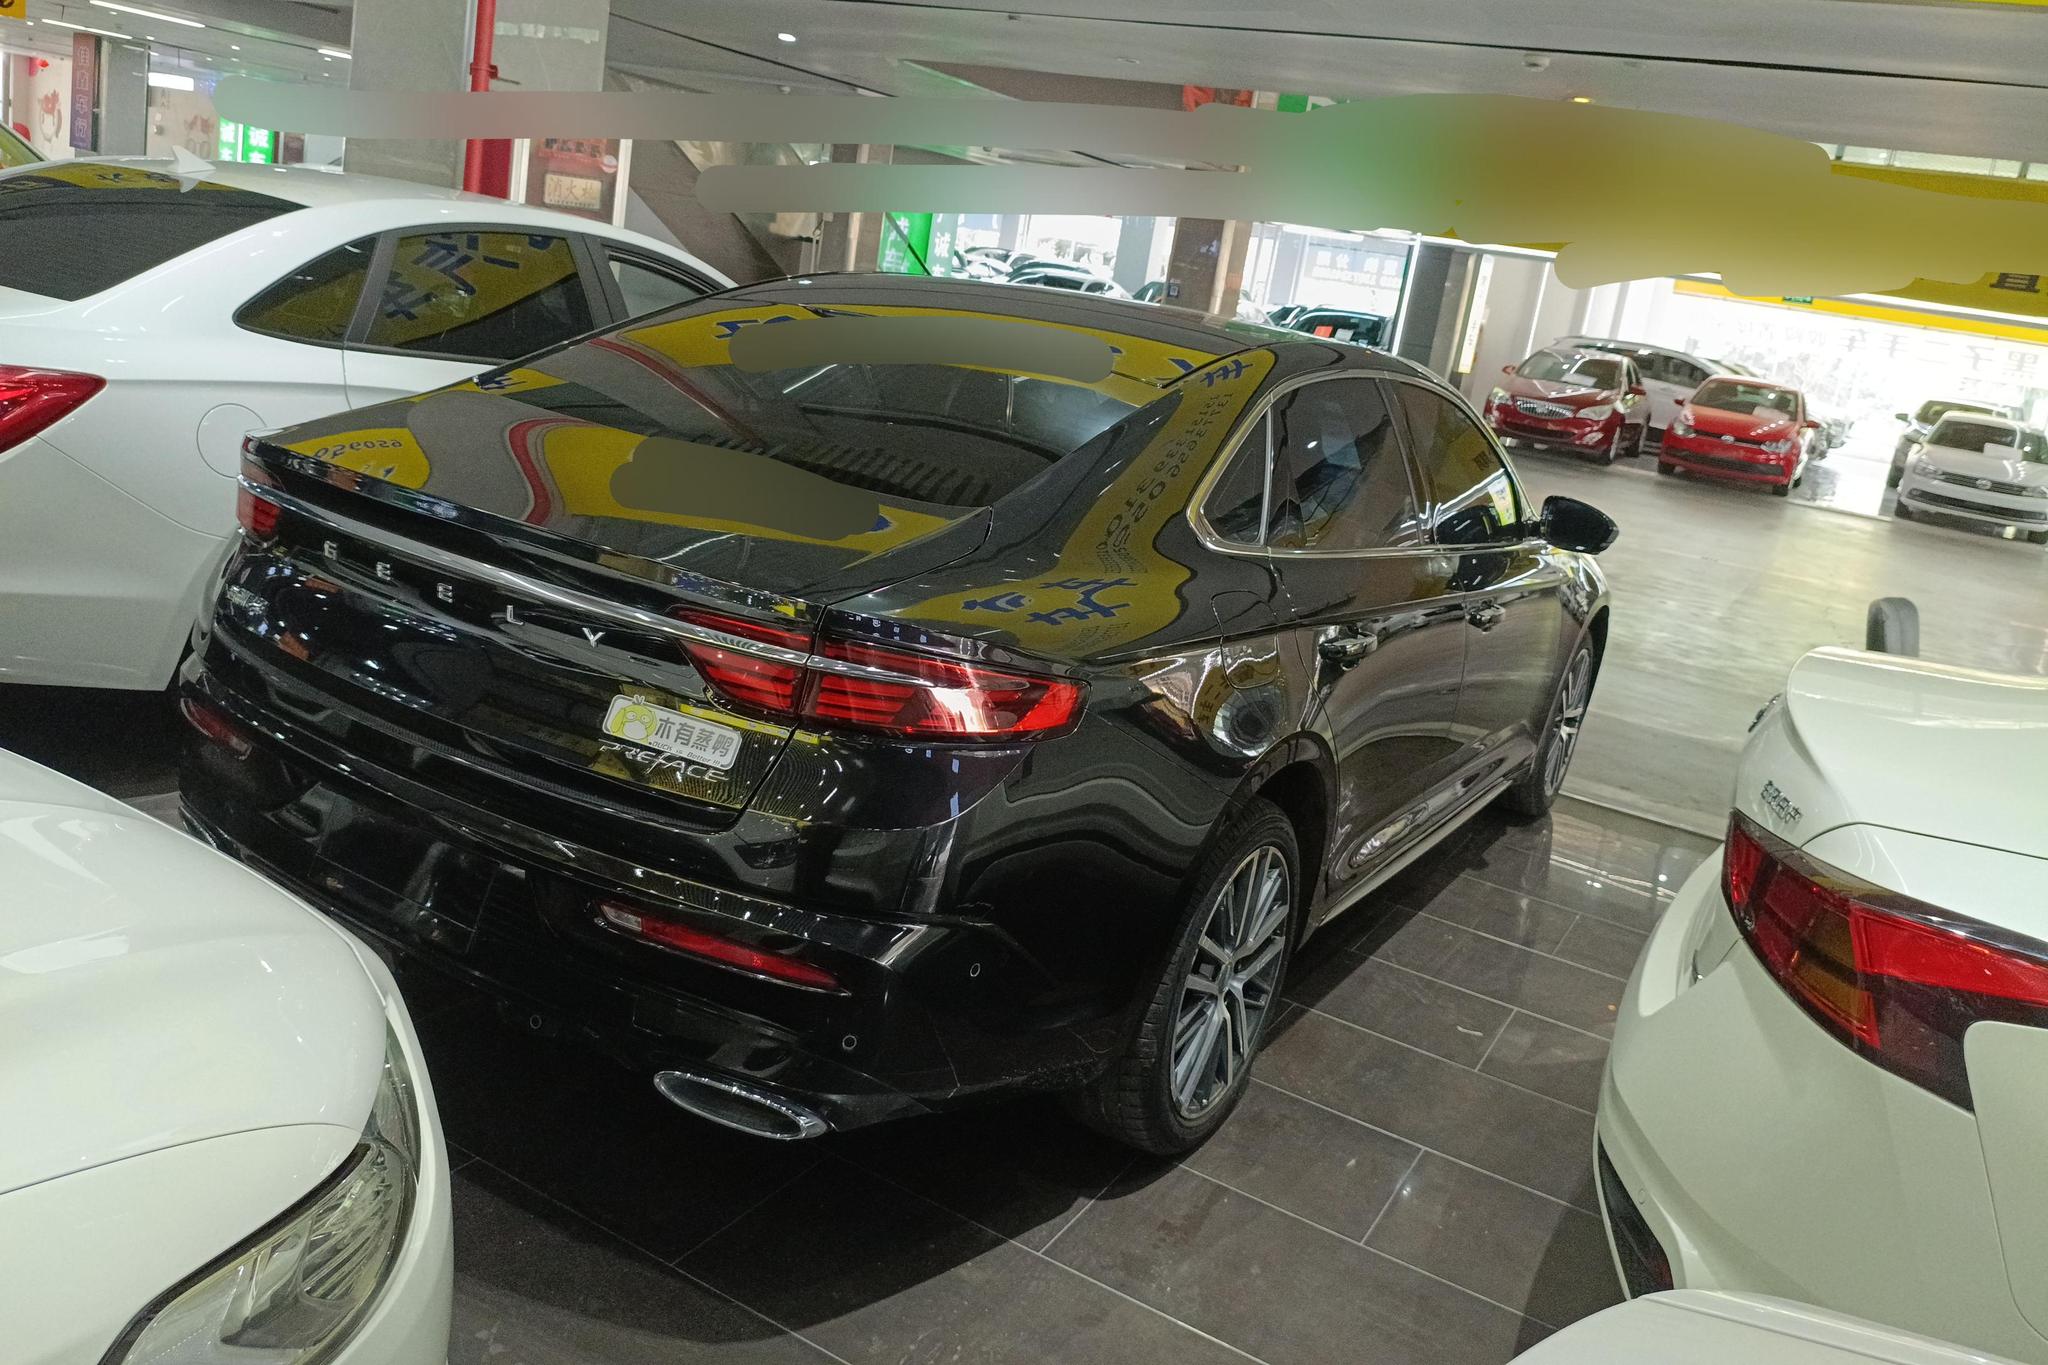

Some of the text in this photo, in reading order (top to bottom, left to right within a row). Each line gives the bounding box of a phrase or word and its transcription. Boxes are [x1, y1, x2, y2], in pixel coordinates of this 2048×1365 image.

[324, 541, 606, 648] GEELY
[655, 717, 734, 757] 木有蒸鸭
[598, 739, 729, 782] PREFACE
